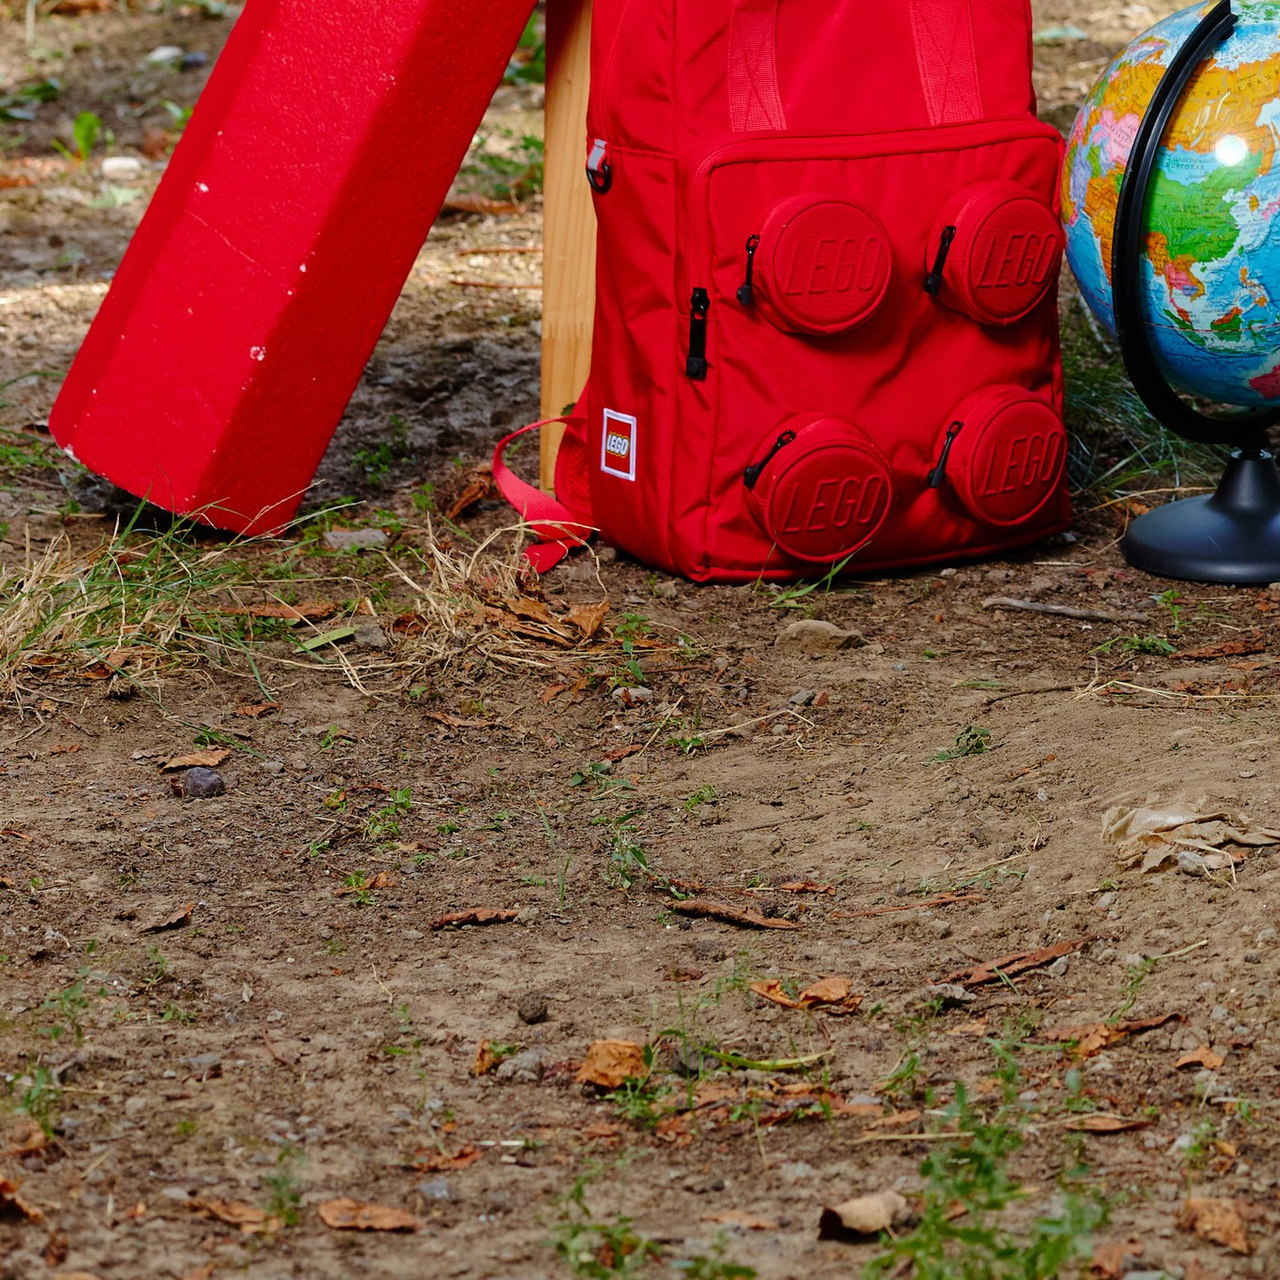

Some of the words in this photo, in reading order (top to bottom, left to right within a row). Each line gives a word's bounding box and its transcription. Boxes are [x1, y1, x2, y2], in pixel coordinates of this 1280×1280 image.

[785, 236, 886, 297] LEGO
[975, 231, 1058, 290] LEGO
[606, 433, 630, 456] LEGO
[980, 429, 1064, 497] LEGO
[781, 474, 888, 534] LEGO
